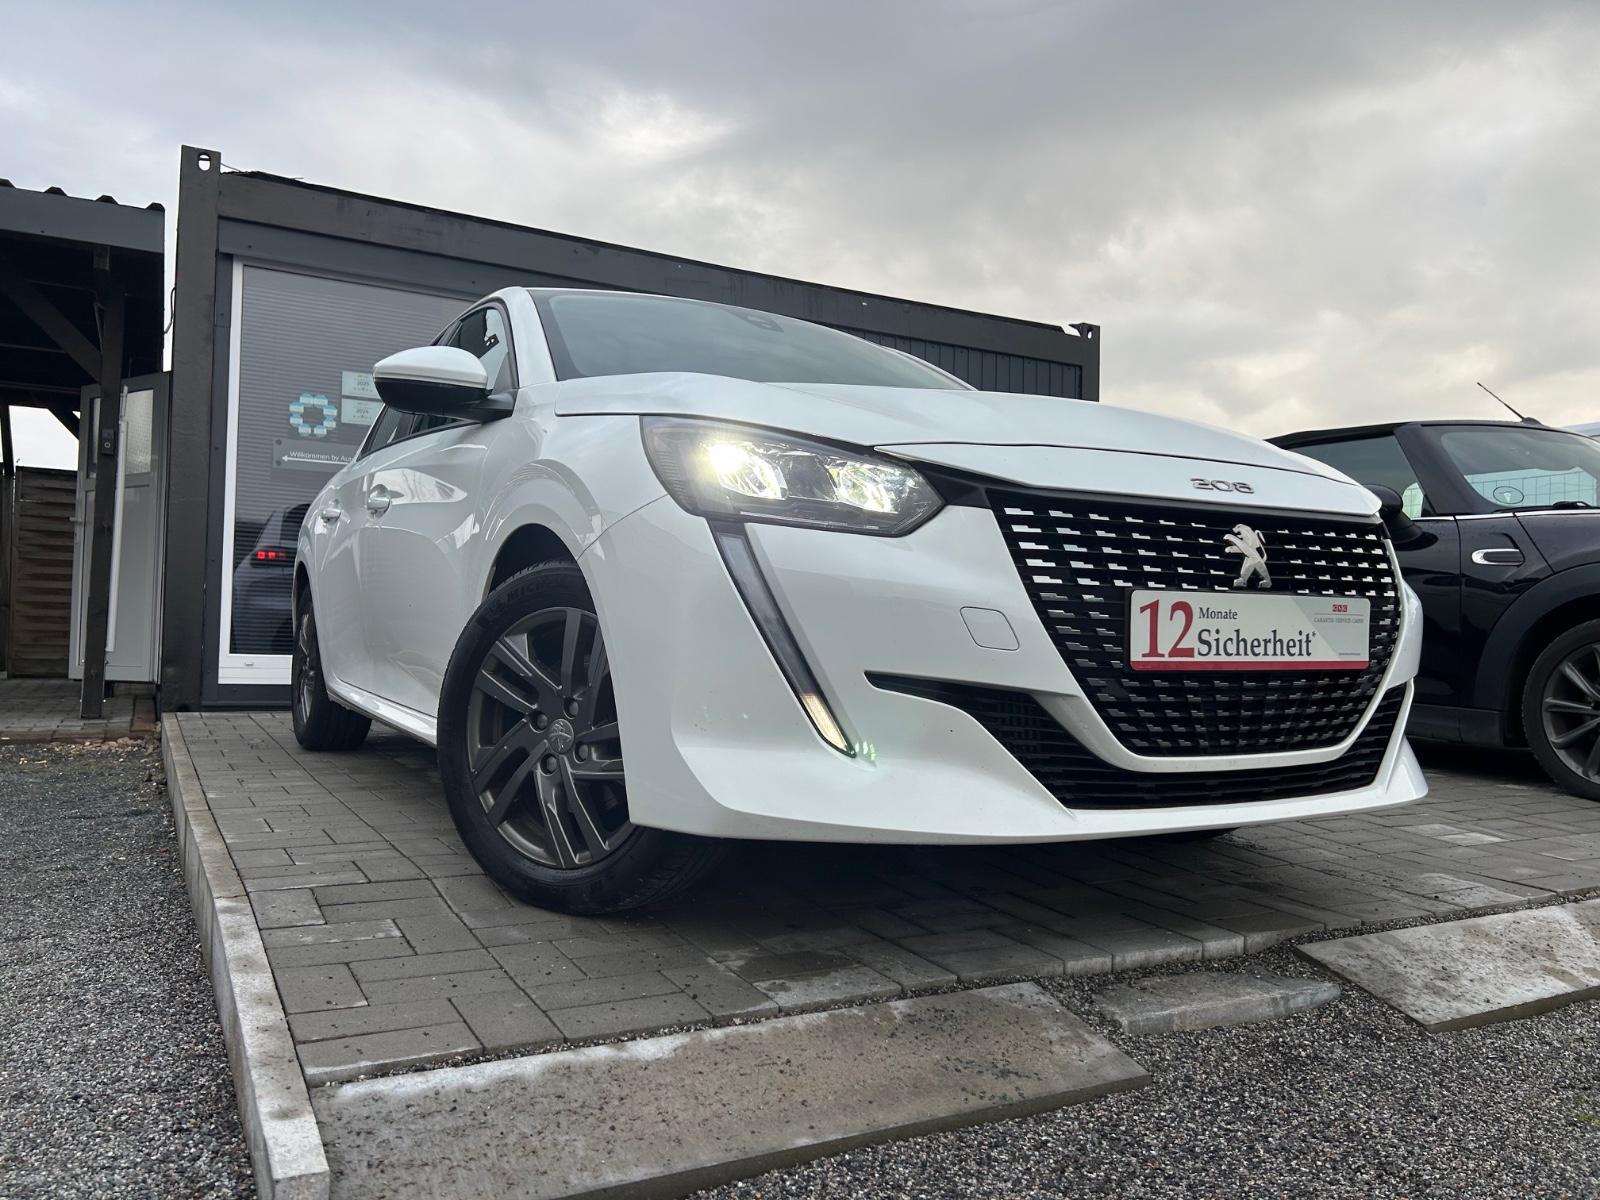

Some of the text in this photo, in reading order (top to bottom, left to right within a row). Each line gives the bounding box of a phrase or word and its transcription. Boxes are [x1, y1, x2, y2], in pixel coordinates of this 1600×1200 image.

[1190, 478, 1254, 494] 208
[1198, 607, 1238, 620] Monate
[1139, 599, 1195, 658] 12
